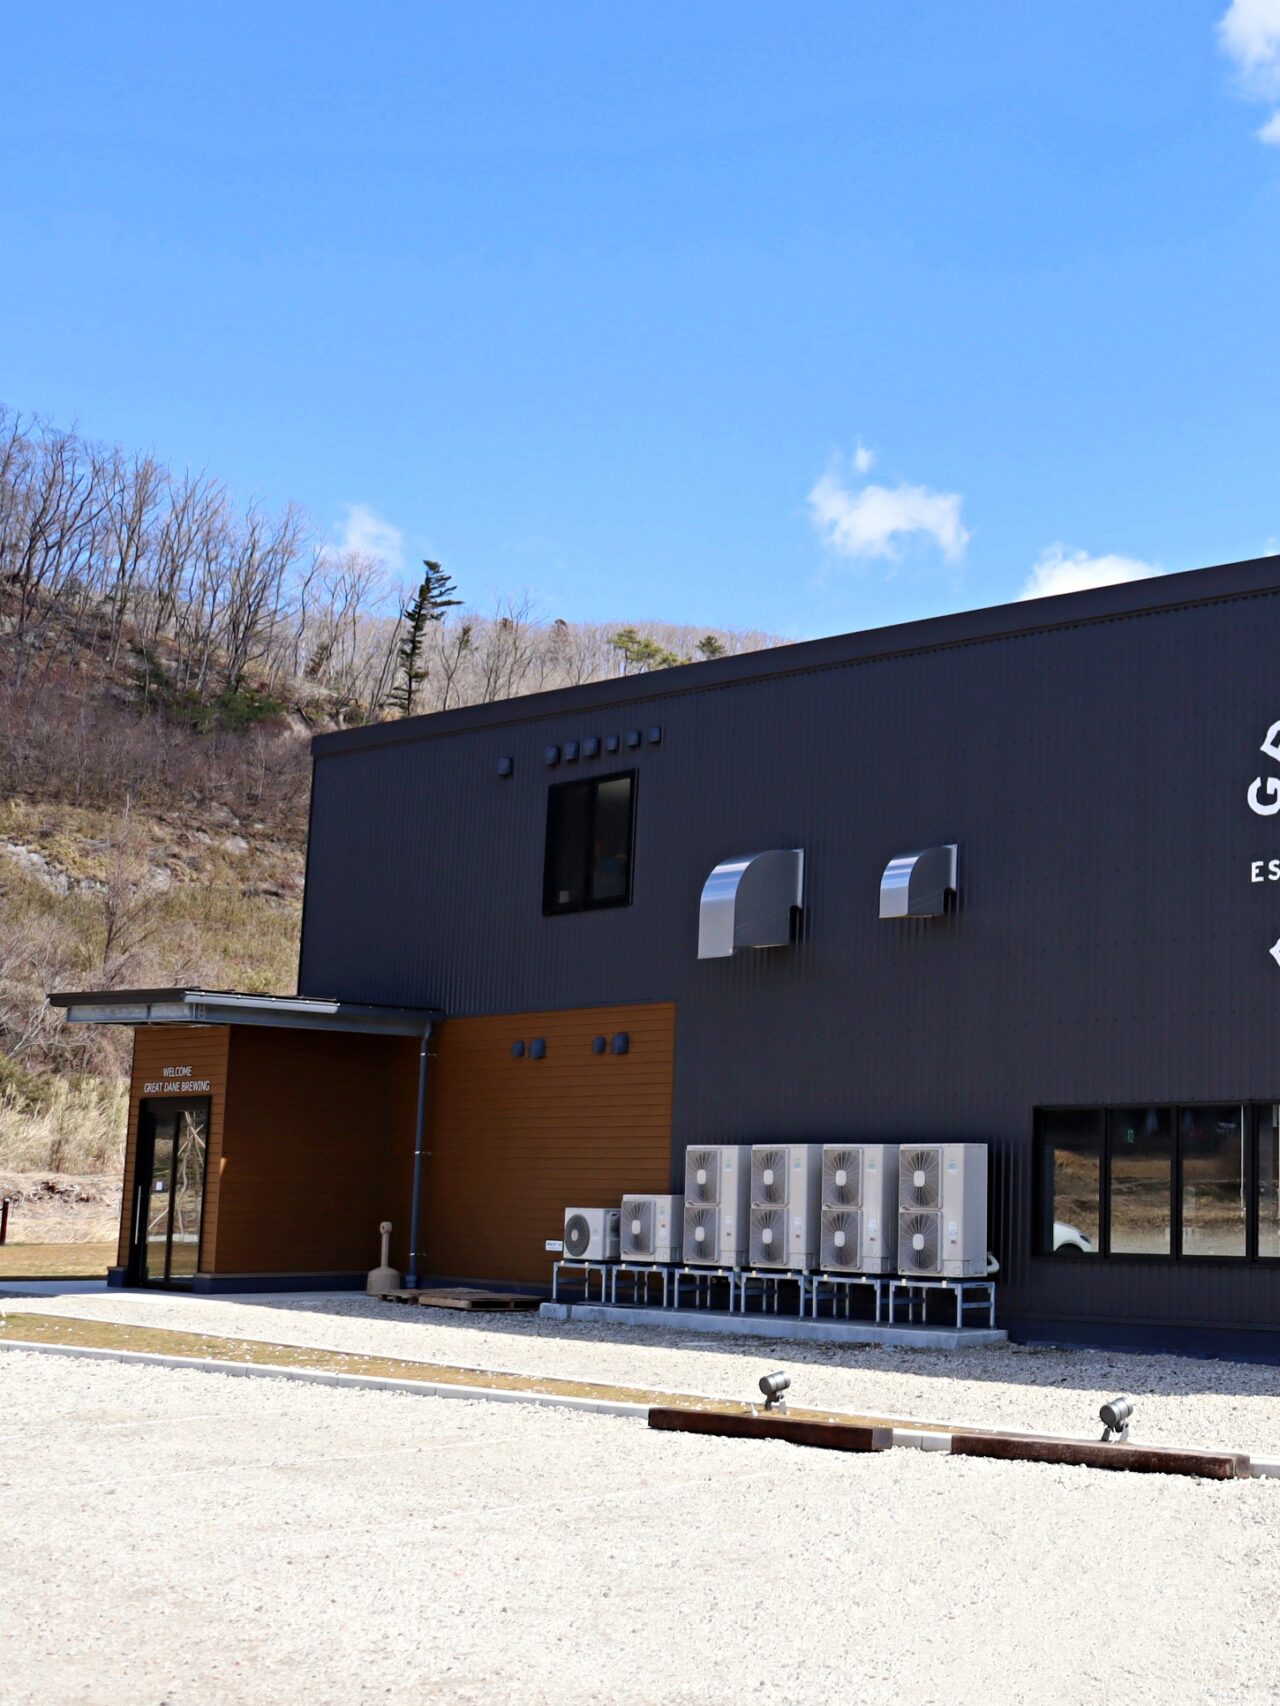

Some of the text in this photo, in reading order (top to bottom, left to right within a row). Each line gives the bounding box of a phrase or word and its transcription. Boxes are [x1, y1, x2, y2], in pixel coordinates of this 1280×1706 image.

[163, 1066, 192, 1077] WELCOME
[144, 1080, 210, 1093] GREAT DANE BREWING
